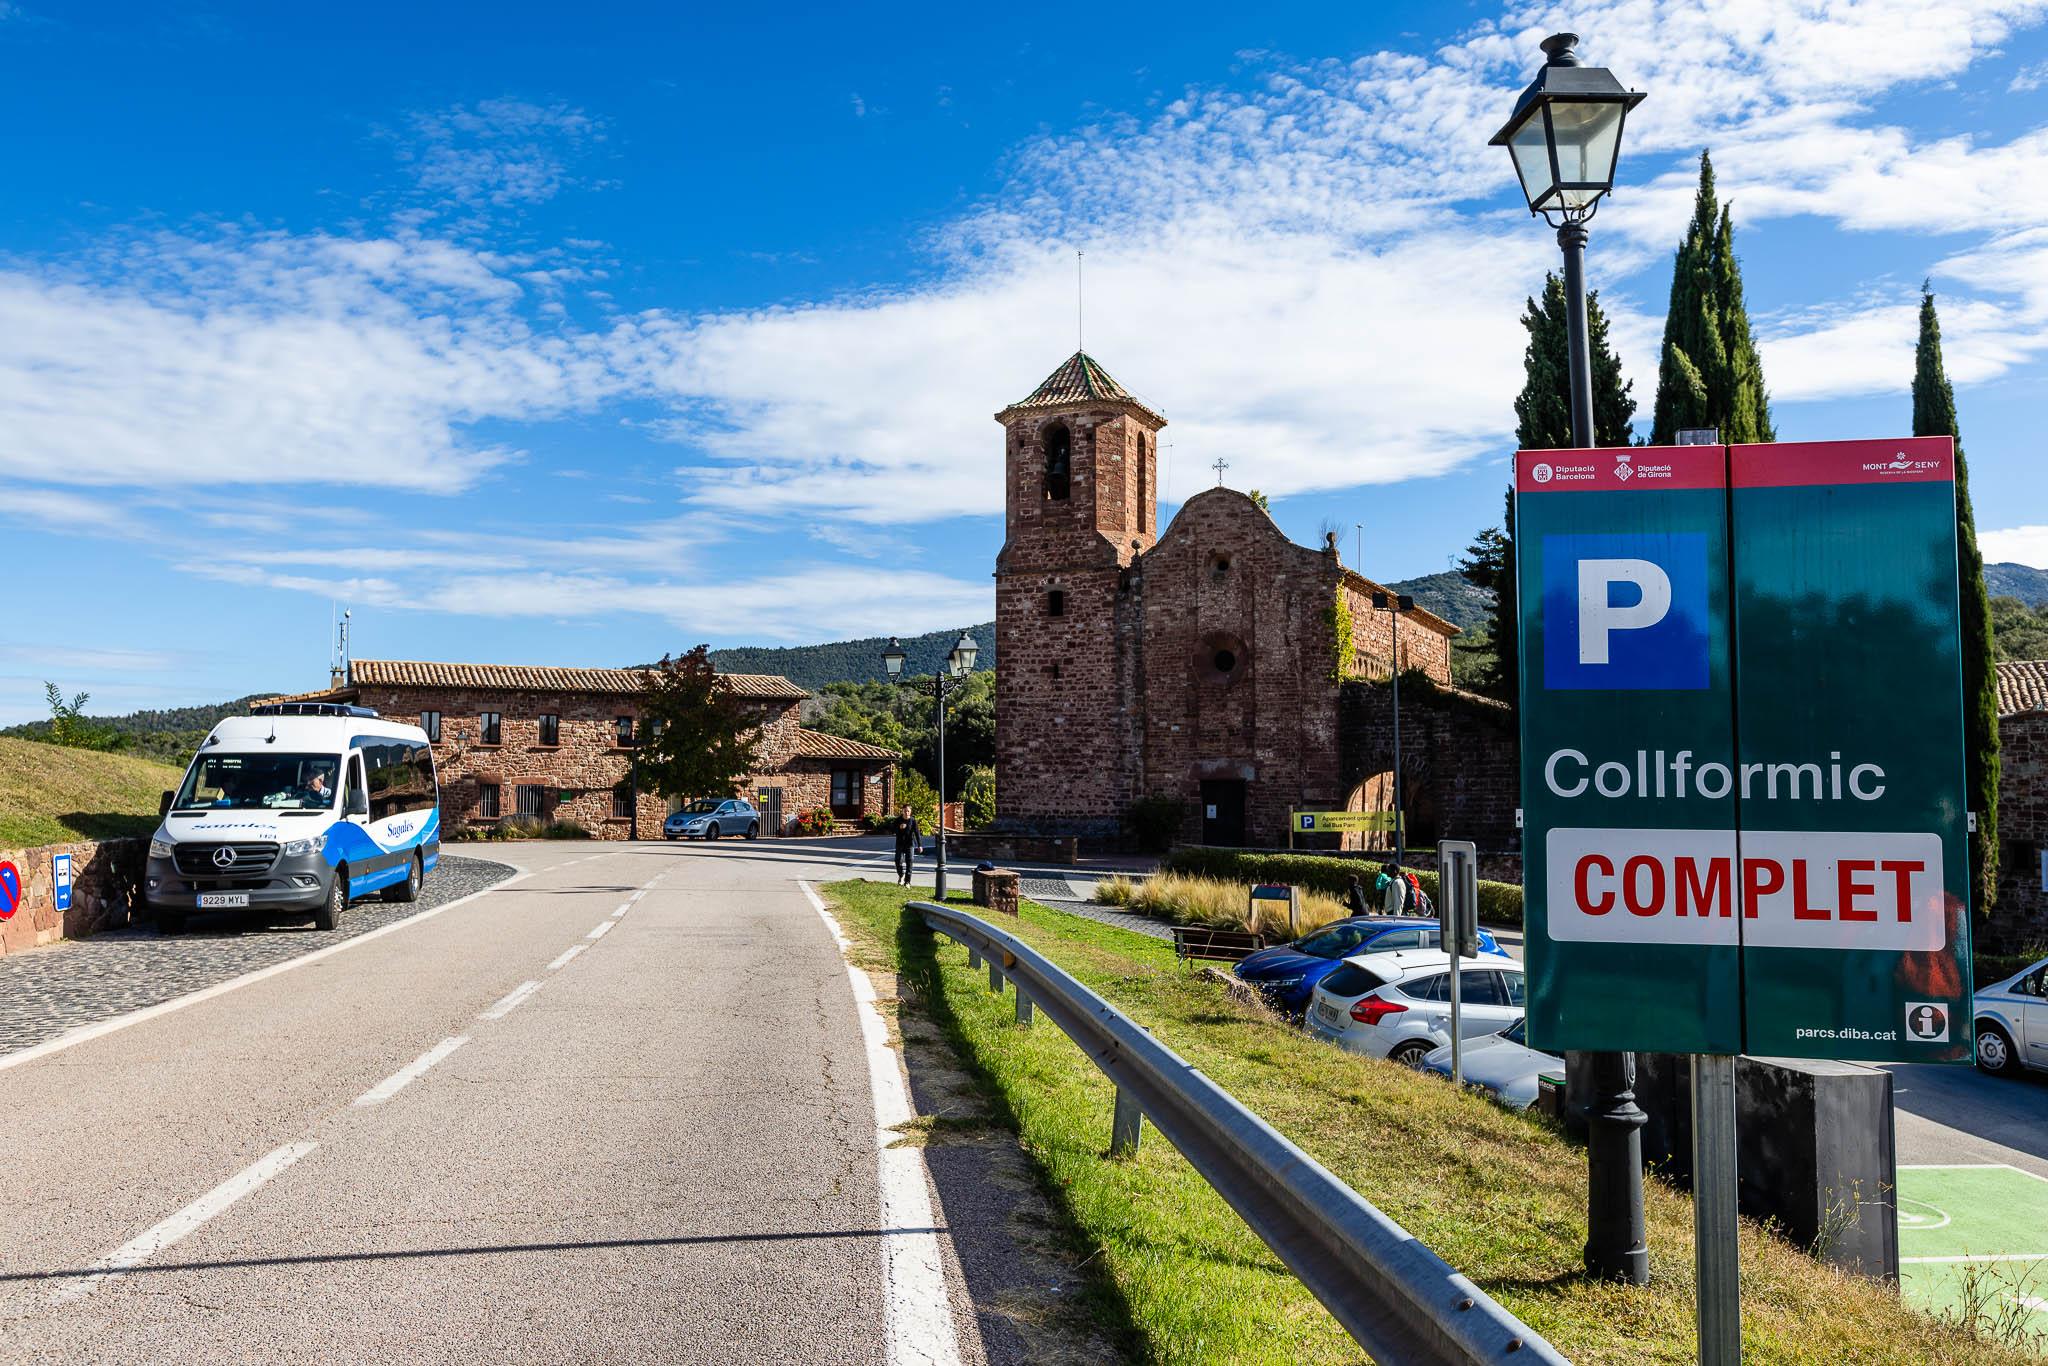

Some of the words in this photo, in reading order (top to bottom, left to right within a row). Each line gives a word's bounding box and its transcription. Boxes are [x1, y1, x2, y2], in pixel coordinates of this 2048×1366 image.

[1556, 465, 1595, 473] Diputació
[1637, 464, 1672, 472] Diputació
[1862, 463, 1888, 471] MONT
[1914, 461, 1940, 469] SENY
[1578, 559, 1671, 664] P
[1544, 748, 1886, 800] Collformic
[1303, 816, 1313, 828] P
[1574, 854, 1925, 923] COMPLET
[202, 896, 226, 905] 9229
[1796, 1027, 1897, 1041] parcs.diba.cat
